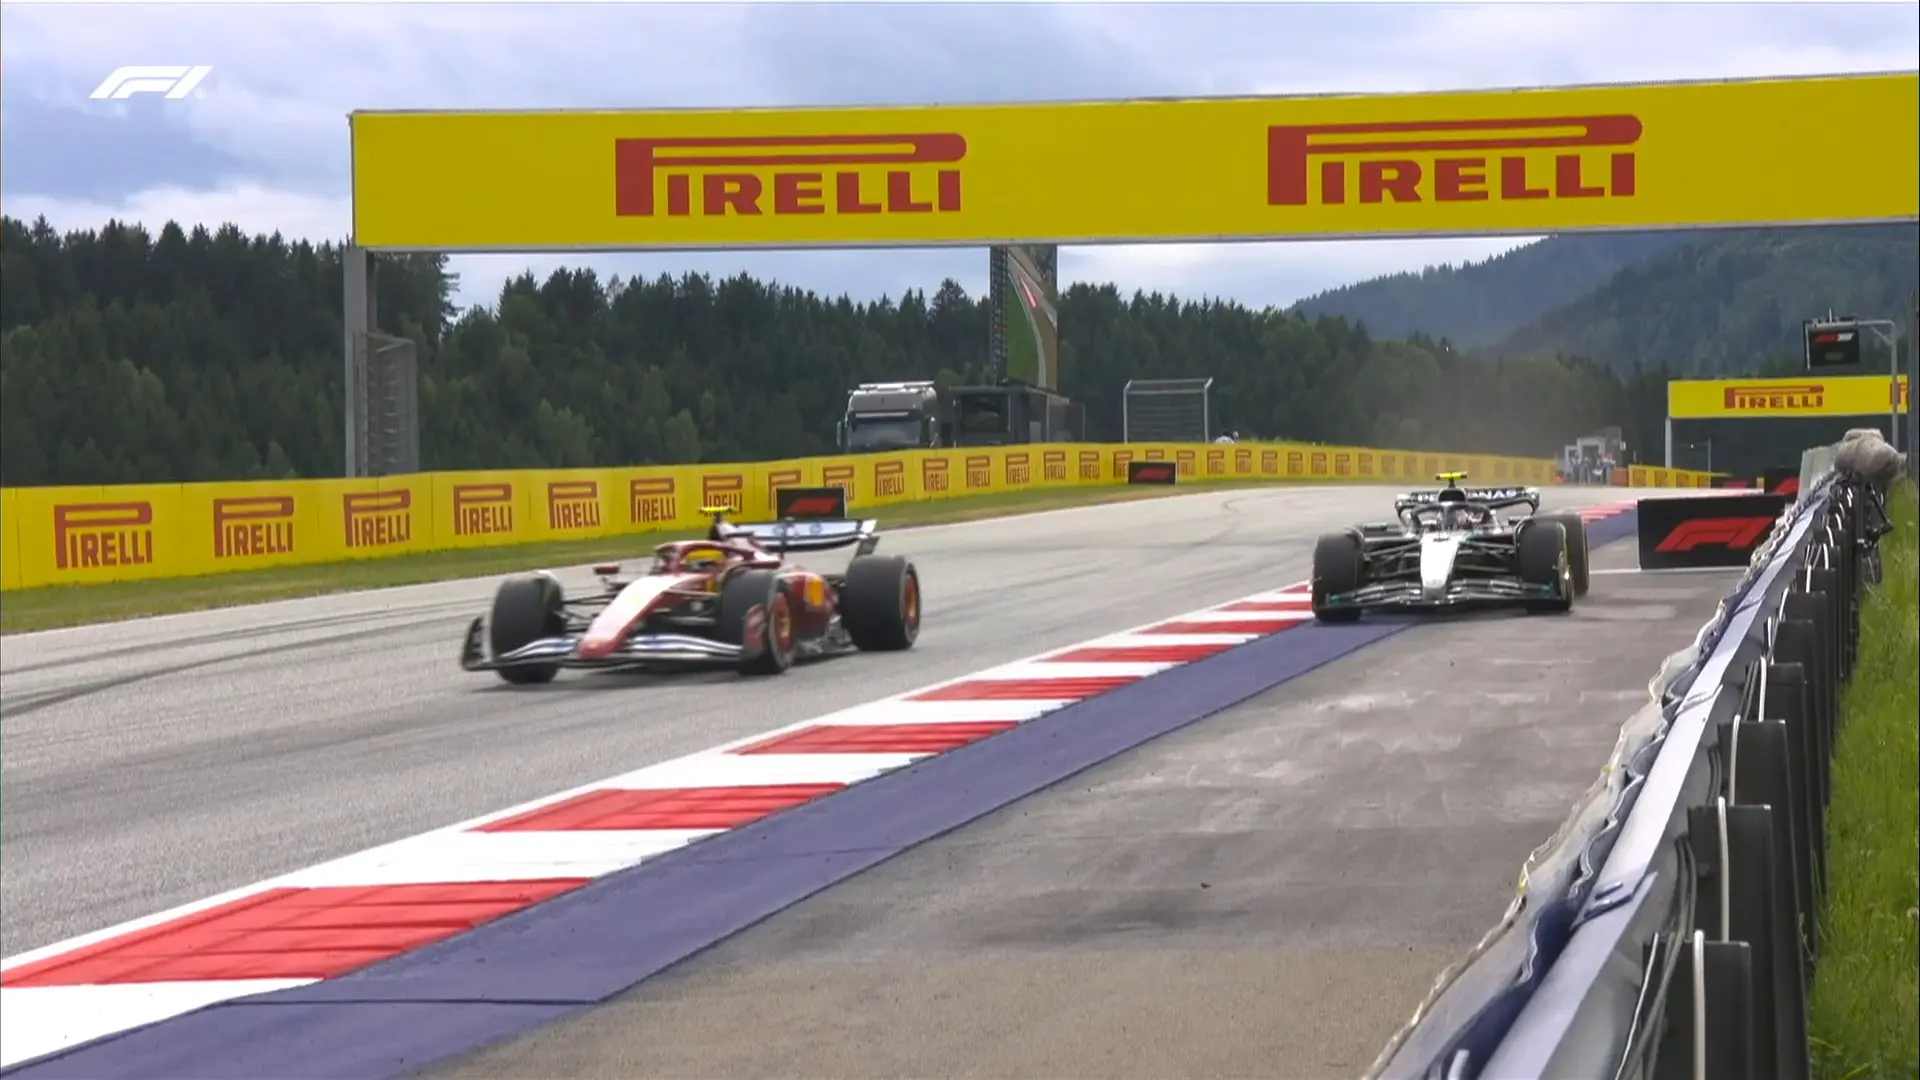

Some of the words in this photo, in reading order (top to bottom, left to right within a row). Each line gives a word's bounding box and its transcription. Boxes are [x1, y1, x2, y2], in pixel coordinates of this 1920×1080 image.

[615, 133, 967, 217] PIRELLI
[1267, 114, 1643, 205] PIRELLI
[1724, 384, 1825, 409] PIRELLI
[547, 481, 602, 530] PIRELLI
[630, 477, 676, 523] PIRELLI
[875, 460, 904, 498] PIRELLI
[54, 501, 153, 570] PIRELLI
[213, 496, 294, 558] PIRELLI
[343, 489, 411, 548] PIRELLI
[453, 483, 513, 536] PIRELLI
[1654, 516, 1775, 553] F1
